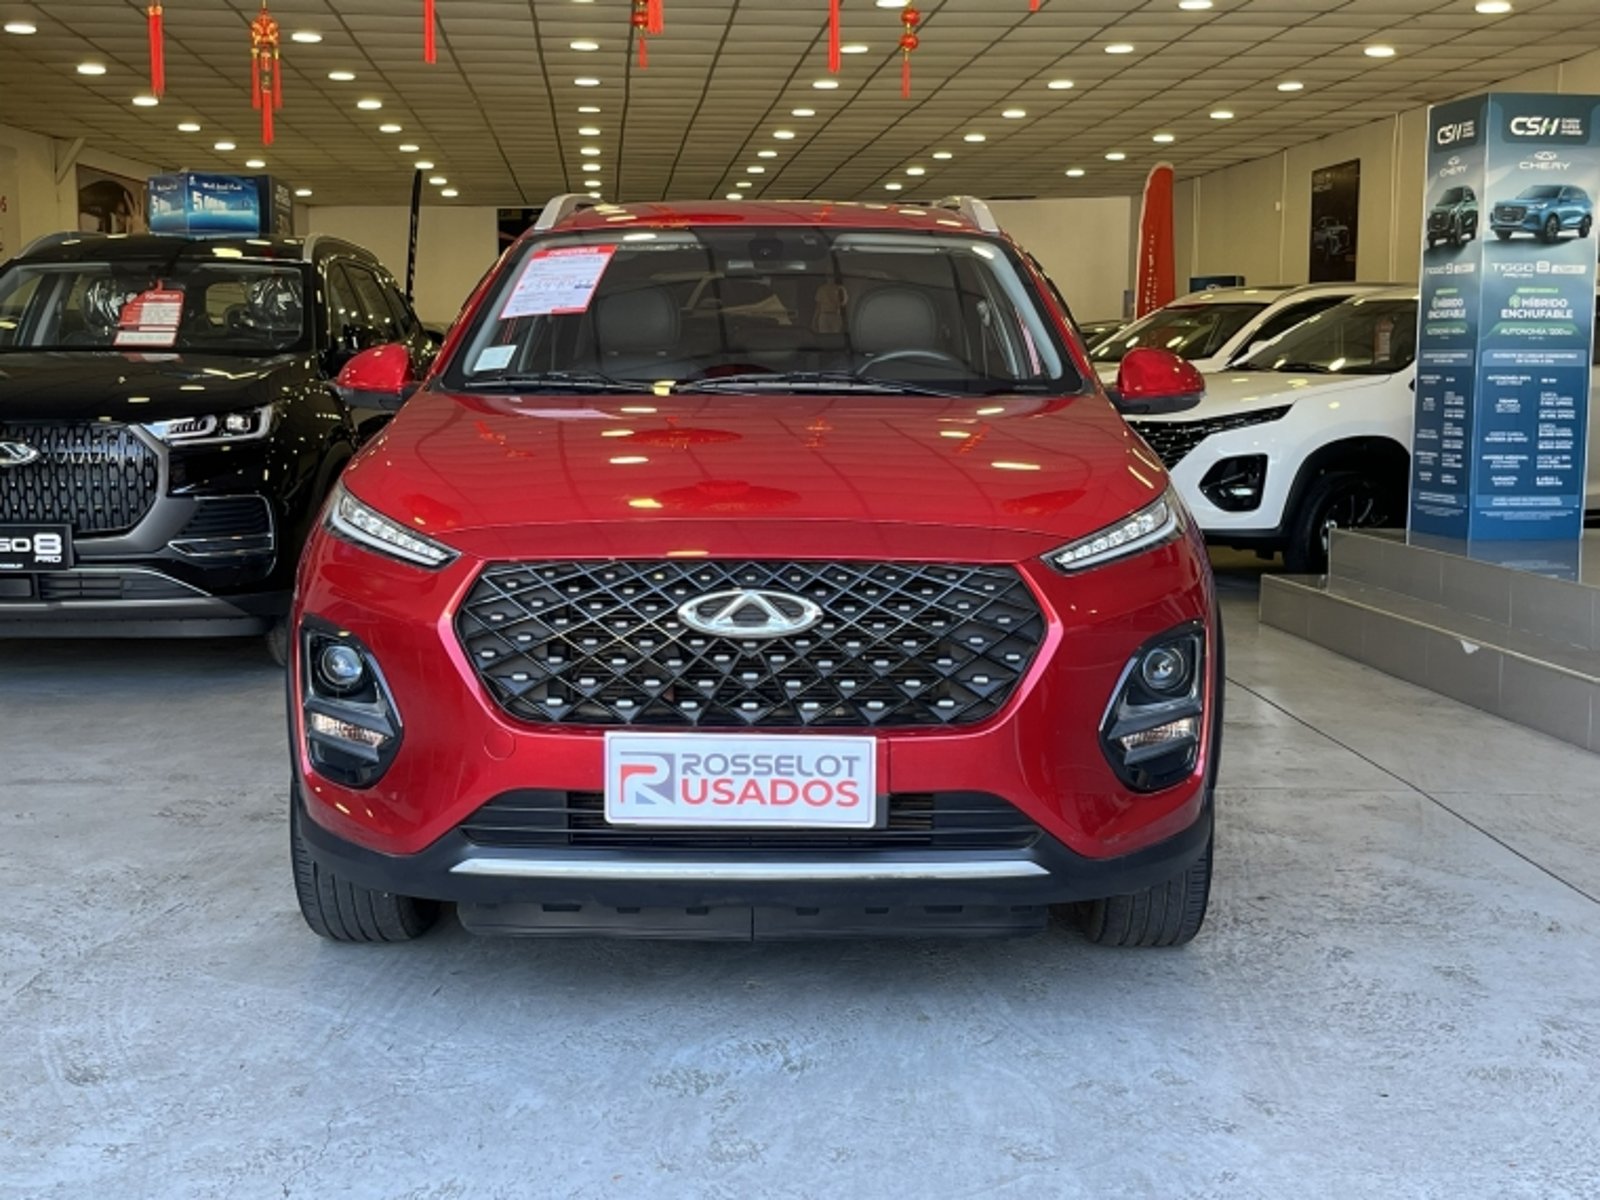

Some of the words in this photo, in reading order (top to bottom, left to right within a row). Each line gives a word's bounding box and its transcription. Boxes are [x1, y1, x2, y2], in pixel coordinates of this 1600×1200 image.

[1519, 161, 1571, 171] CHERY
[1492, 262, 1535, 273] TIGGO
[1536, 260, 1551, 274] 8
[1521, 296, 1568, 308] HÍBRIDO
[1500, 309, 1574, 319] ENCHUFABLE
[33, 533, 62, 554] 8
[34, 555, 62, 563] PRO
[682, 753, 861, 778] ROSSELOT
[681, 778, 860, 808] USADOS
